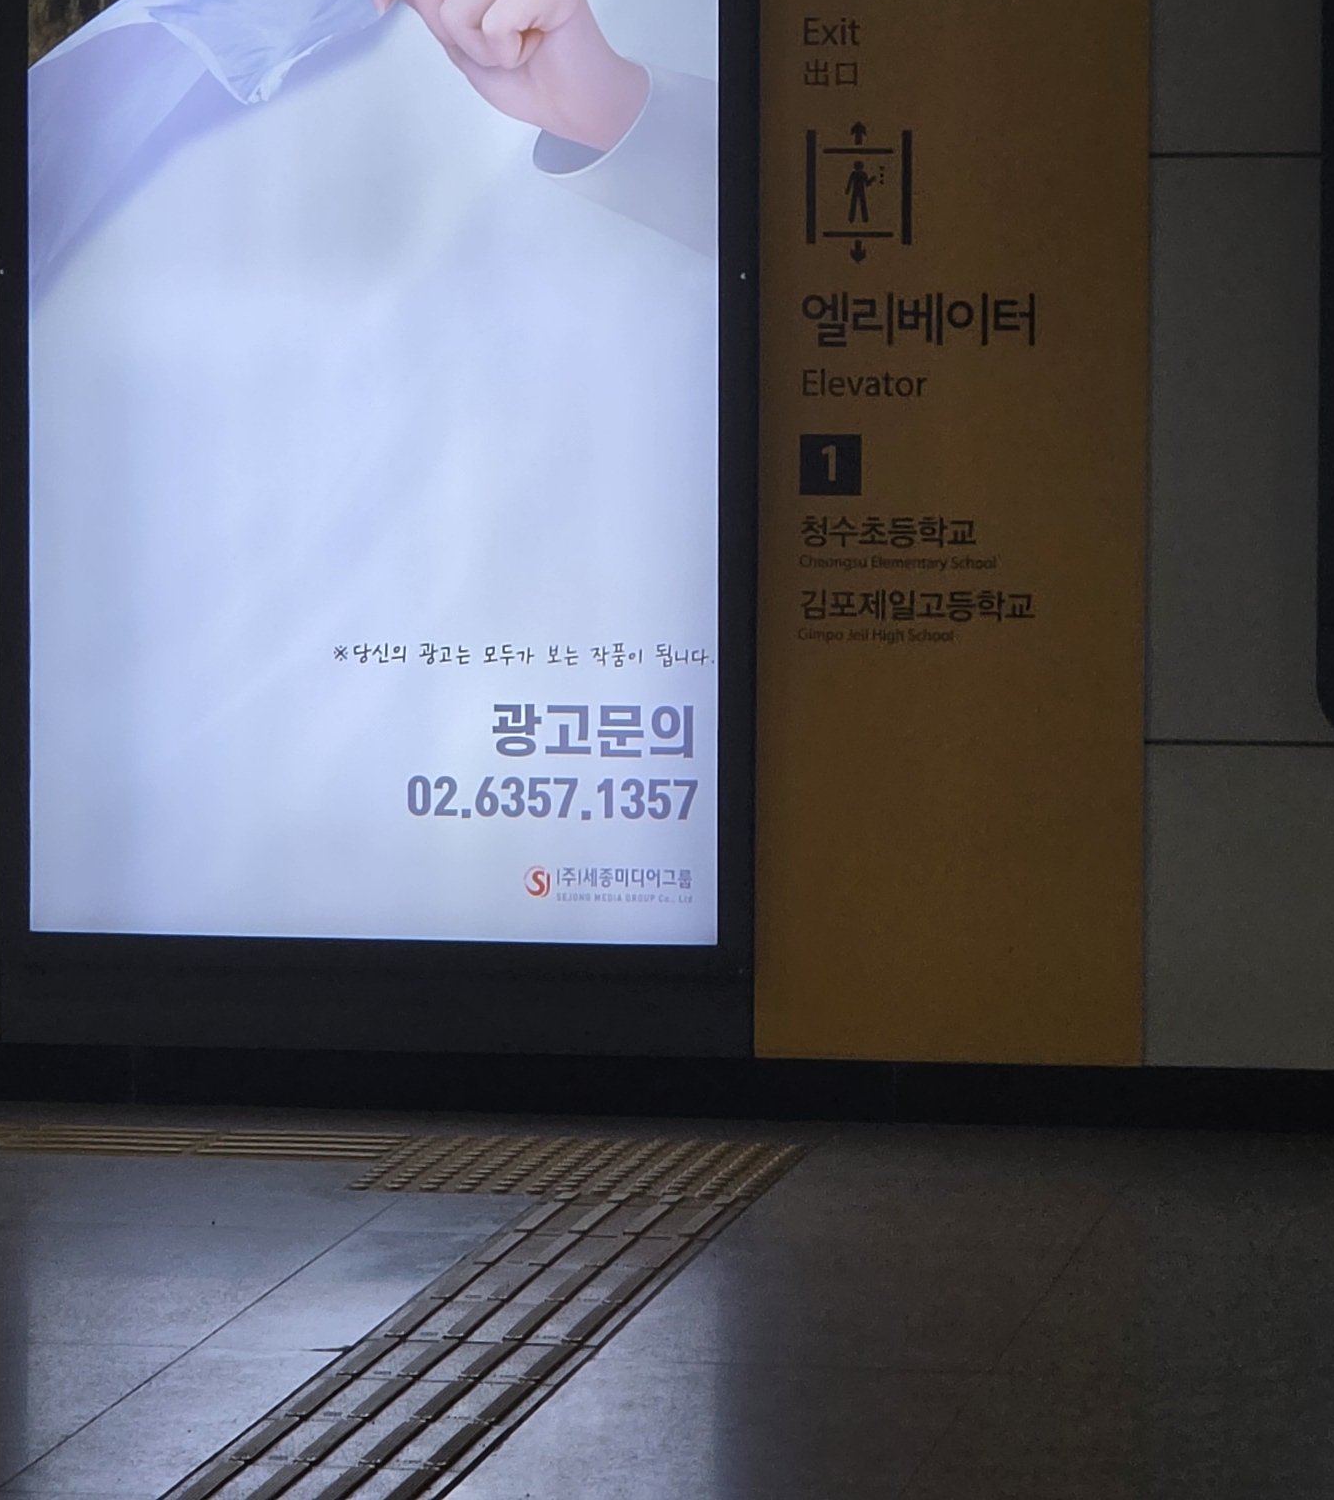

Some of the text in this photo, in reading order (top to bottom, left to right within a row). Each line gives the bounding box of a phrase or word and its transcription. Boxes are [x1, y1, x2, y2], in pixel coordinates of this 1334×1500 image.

[803, 18, 860, 46] Exit
[804, 60, 858, 87] 出口
[802, 292, 1035, 347] 엘리베이터
[803, 370, 927, 396] Elevator
[822, 444, 837, 482] 1
[800, 516, 976, 548] 청수초등학교
[799, 555, 997, 572] Cheongsu Elementary School
[800, 589, 1035, 622] 김포제일고등학교
[798, 628, 843, 644] Gimpo
[872, 628, 904, 645] High
[907, 628, 954, 643] School
[419, 643, 471, 665] 광고는
[484, 644, 534, 666] 모두가
[547, 644, 579, 666] 보는
[591, 642, 643, 668] 작품이
[655, 643, 715, 668] 됩니다.
[493, 704, 694, 759] 광고문의
[407, 775, 699, 821] 02.6357.1357
